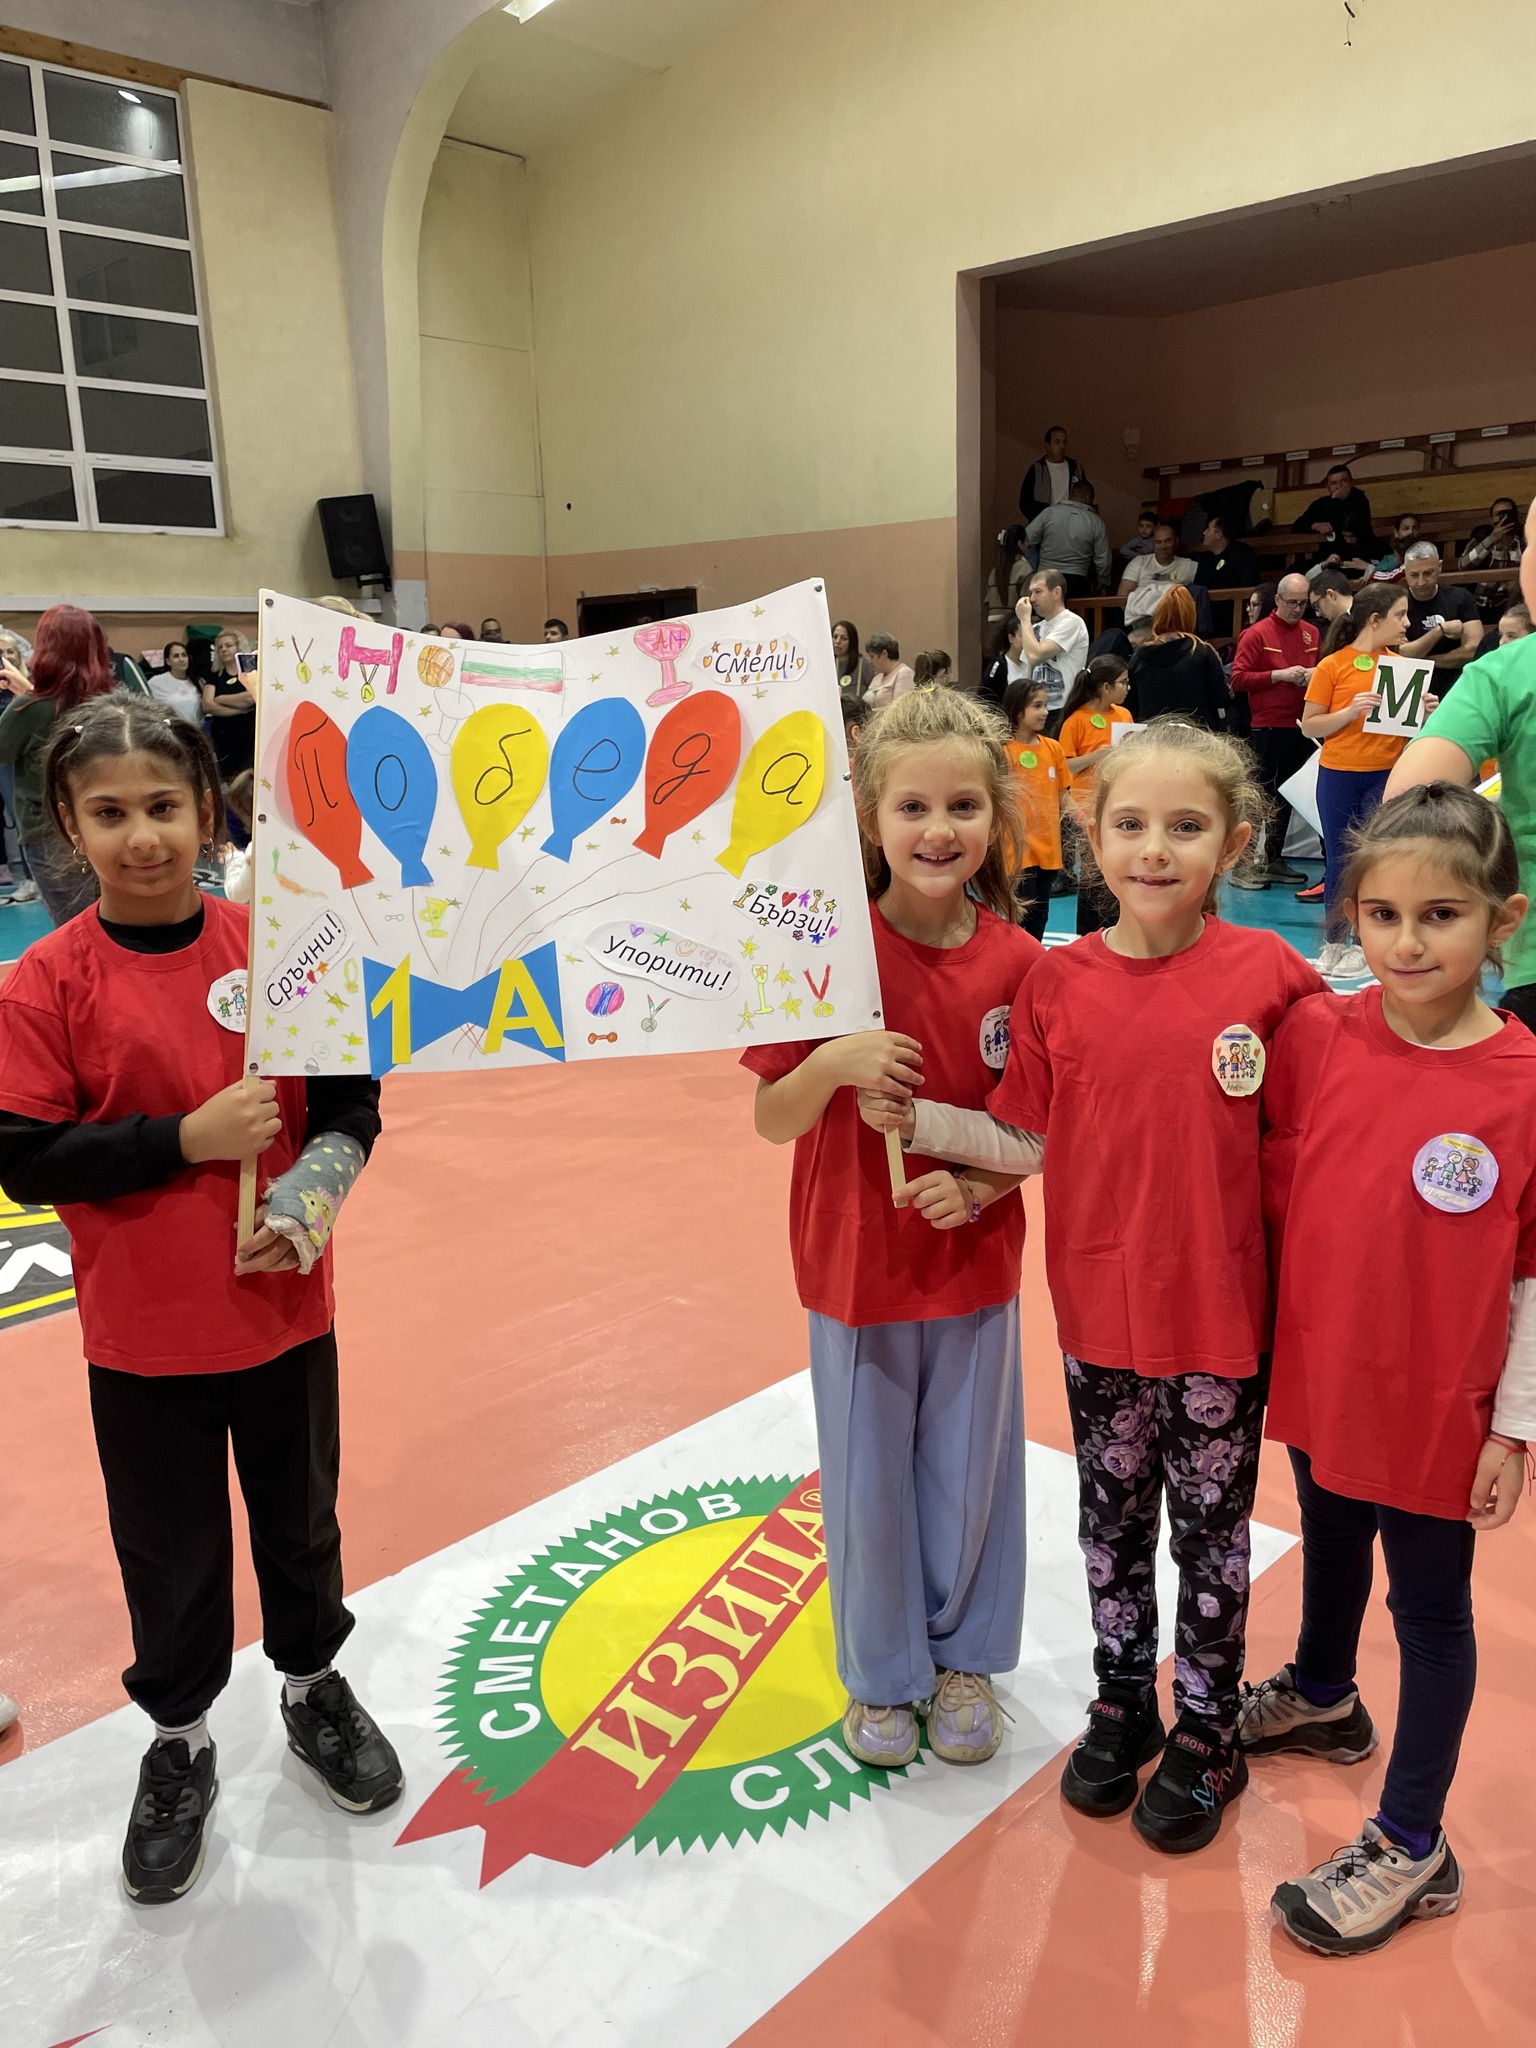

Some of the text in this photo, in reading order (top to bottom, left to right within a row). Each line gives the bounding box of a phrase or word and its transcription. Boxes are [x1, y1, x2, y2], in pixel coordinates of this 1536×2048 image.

[714, 645, 796, 675] Смели!
[294, 717, 813, 827] Победа
[748, 894, 834, 937] Бързи!
[266, 913, 342, 1006] Сръчни!
[602, 935, 732, 991] Упорити!
[370, 952, 565, 1065] 1 А
[473, 1492, 743, 1740] СМЕТАНОВ
[1092, 1702, 1125, 1720] SPORT
[1174, 1733, 1214, 1757] SPORT
